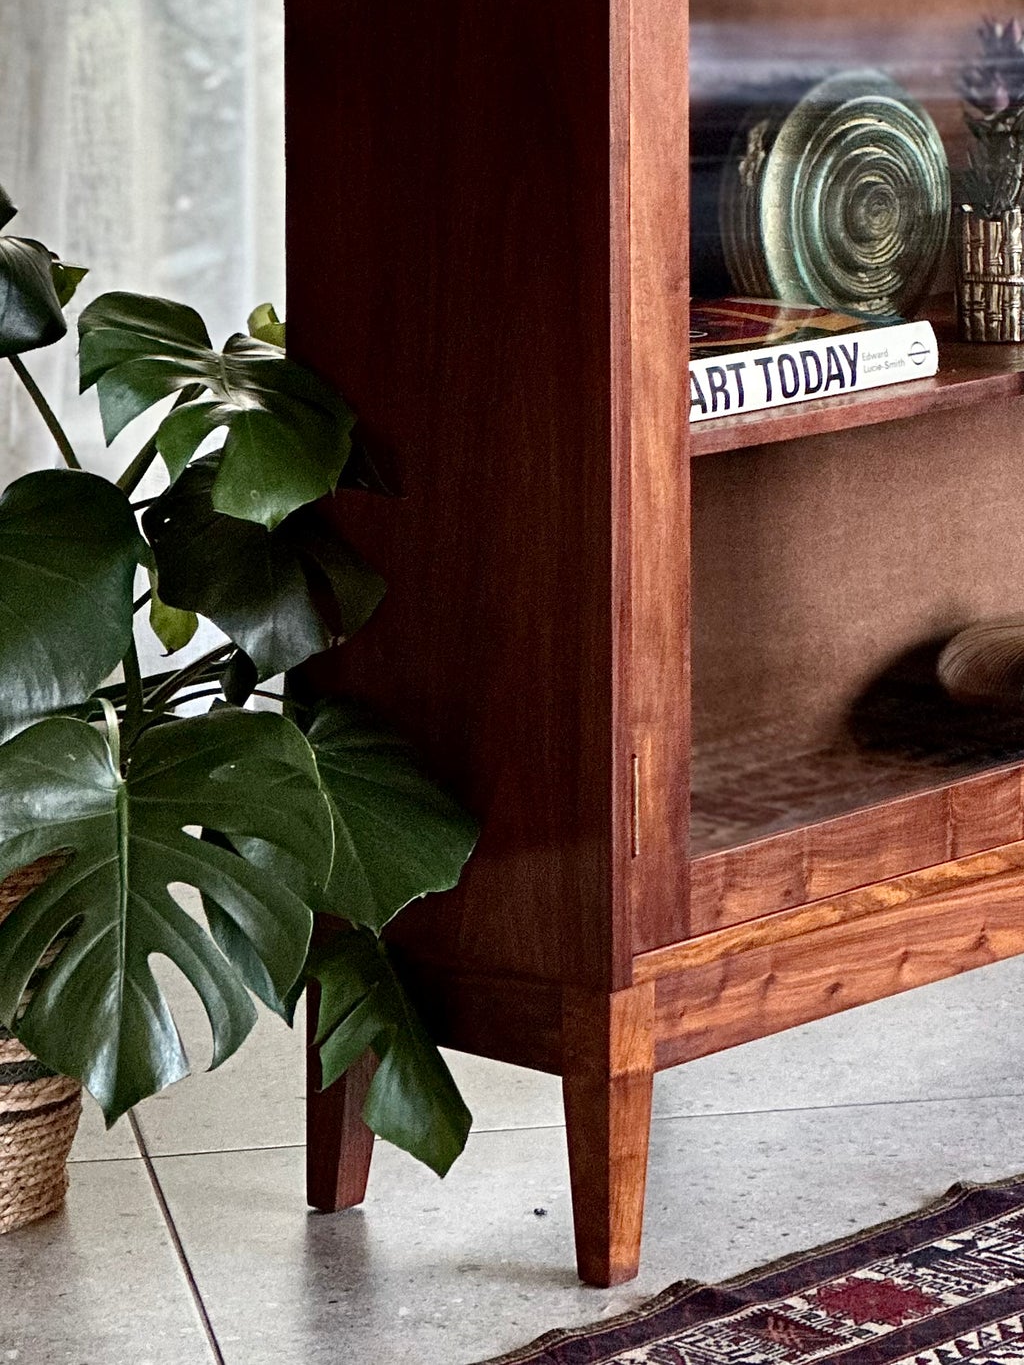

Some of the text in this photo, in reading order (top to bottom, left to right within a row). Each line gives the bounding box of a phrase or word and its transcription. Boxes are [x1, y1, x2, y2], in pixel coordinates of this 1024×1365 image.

[862, 347, 889, 362] Edward
[690, 341, 859, 414] ART TODAY
